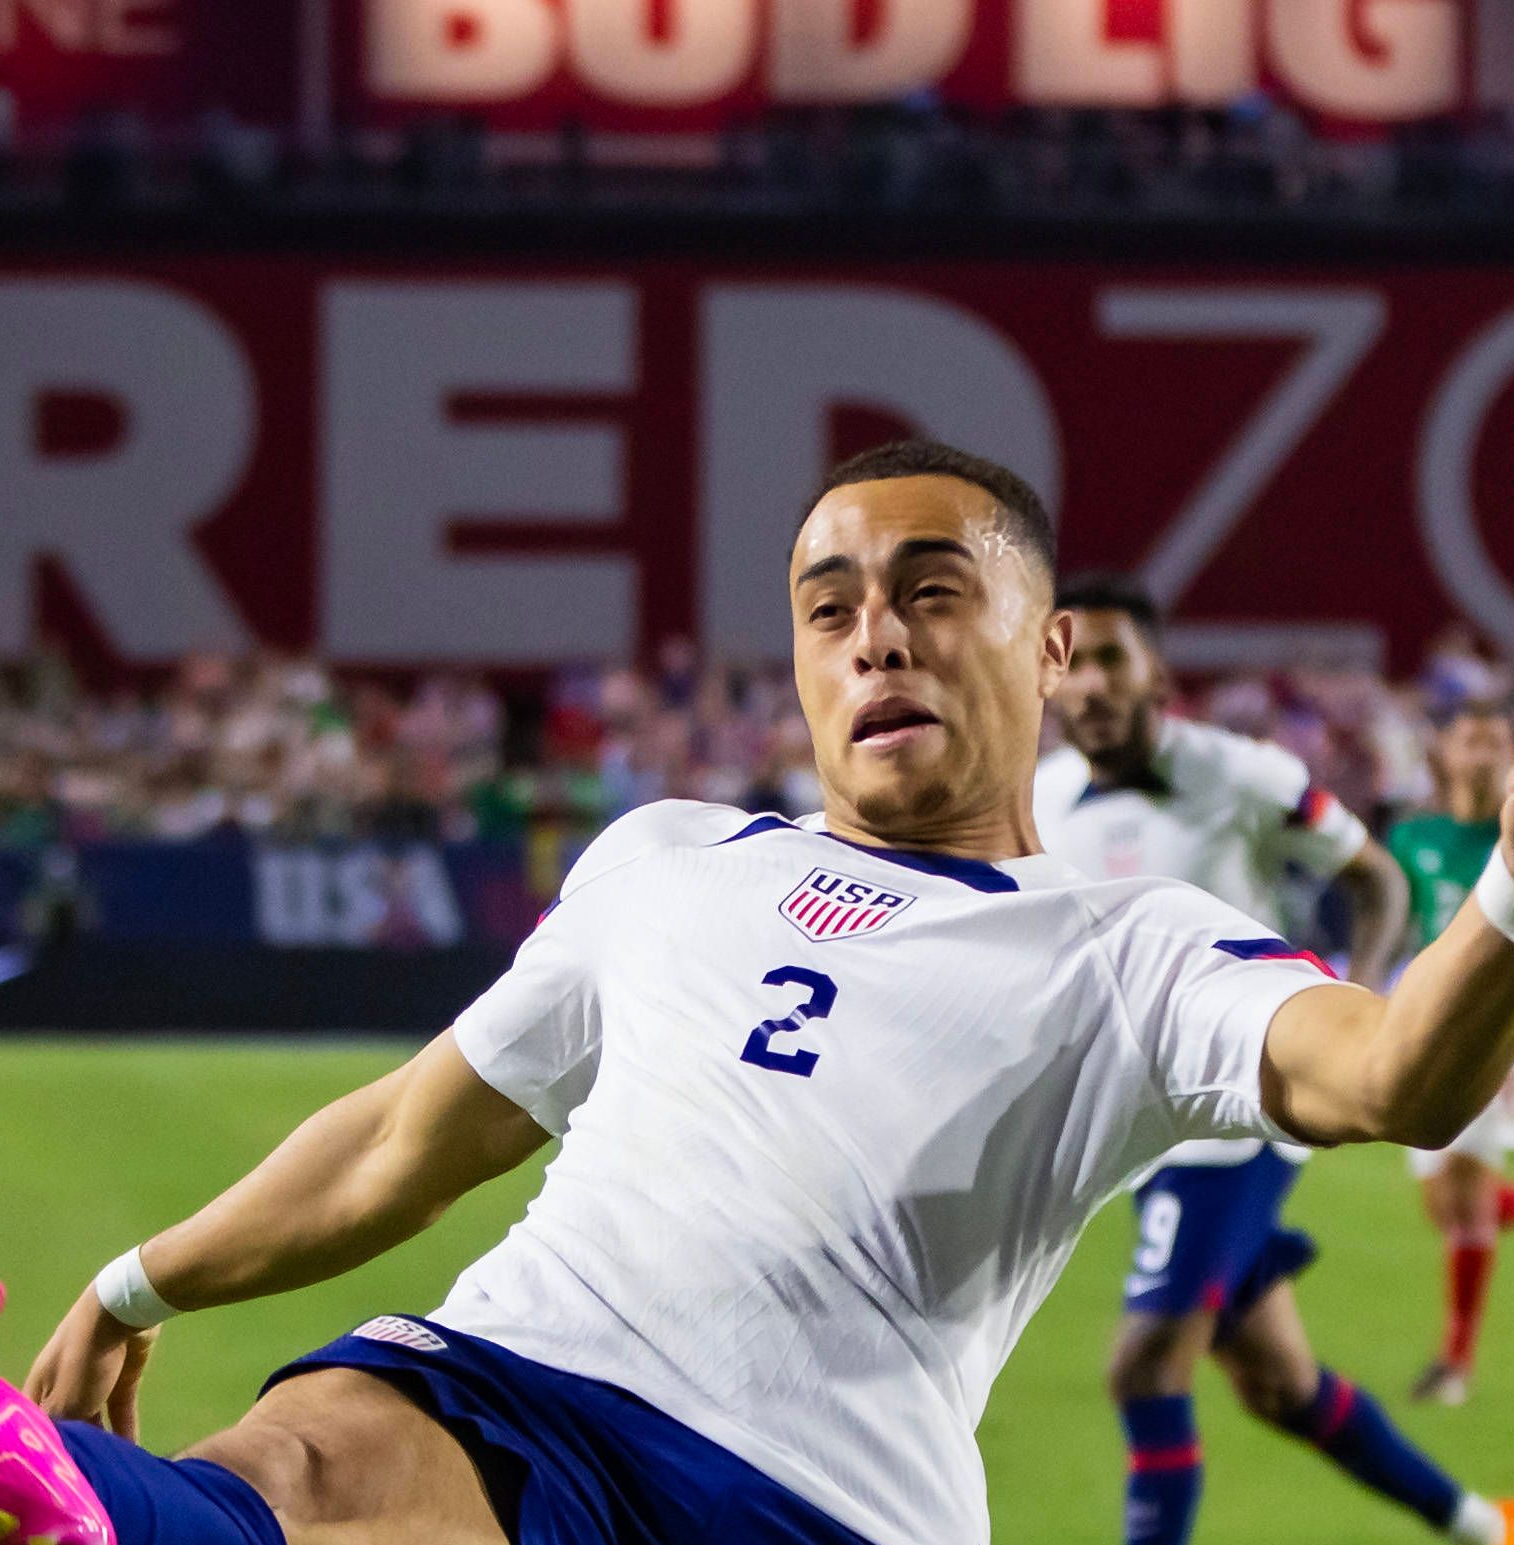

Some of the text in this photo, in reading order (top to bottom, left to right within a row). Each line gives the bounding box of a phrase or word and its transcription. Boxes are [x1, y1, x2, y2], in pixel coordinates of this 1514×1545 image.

[810, 874, 904, 908] USA
[740, 965, 839, 1078] 2
[1134, 1190, 1182, 1275] 9
